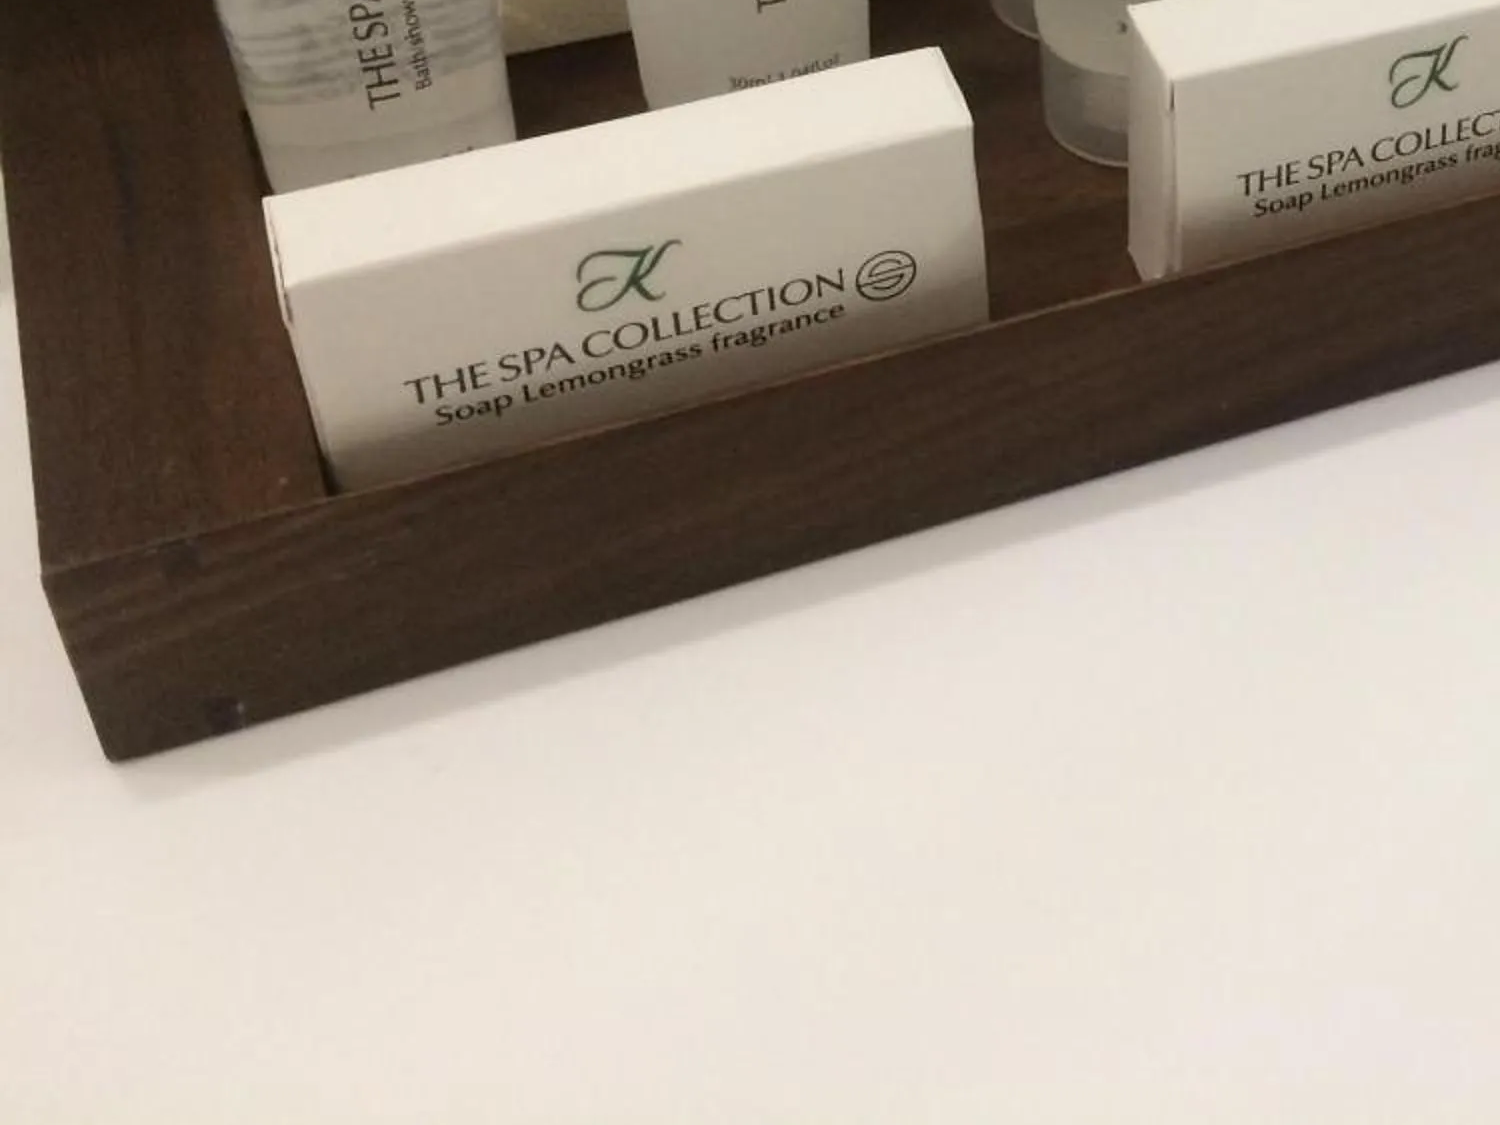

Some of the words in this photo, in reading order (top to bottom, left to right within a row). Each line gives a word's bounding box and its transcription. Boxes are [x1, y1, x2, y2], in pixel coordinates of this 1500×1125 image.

[358, 43, 401, 111] THE
[1237, 160, 1301, 197] THE
[1306, 145, 1365, 180] SPA
[1252, 189, 1314, 219] Soap
[1320, 152, 1459, 202] Lemongrass
[403, 362, 492, 405] THE
[497, 341, 577, 382] SPA
[581, 267, 848, 359] COLLECTION
[434, 390, 514, 426] Soap
[522, 342, 703, 404] Lemongrass
[710, 303, 847, 354] fragrance
